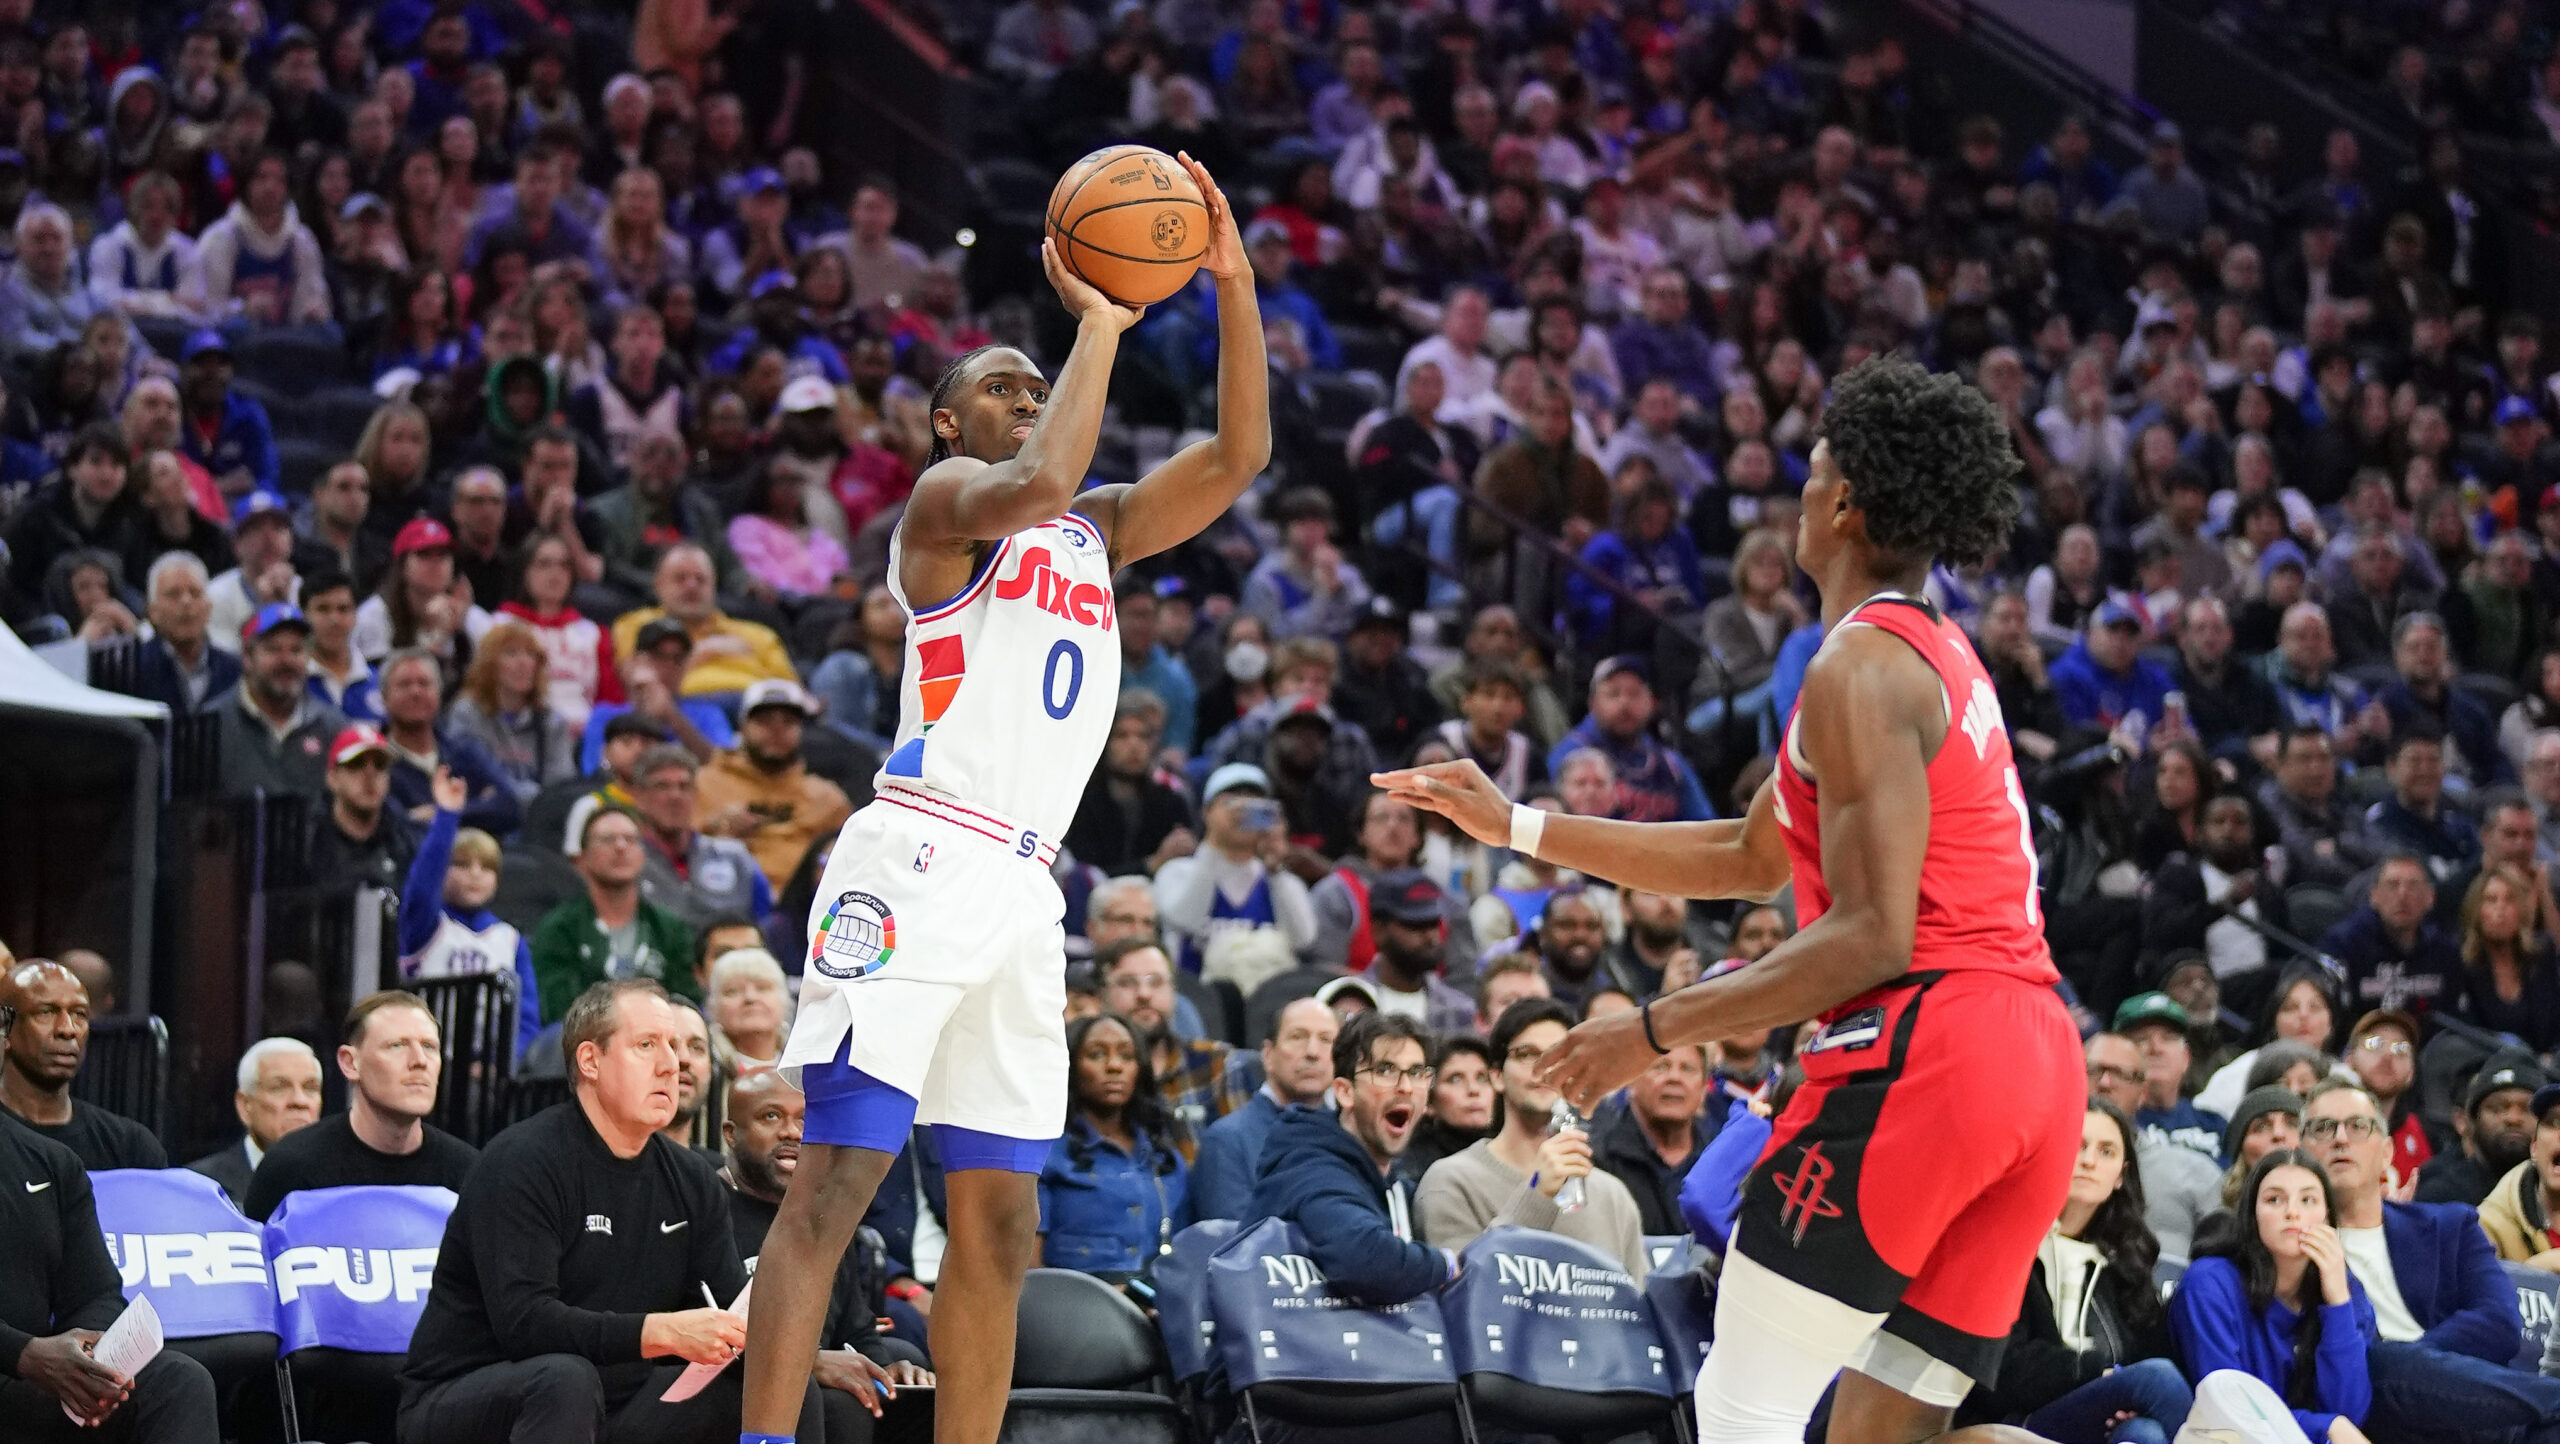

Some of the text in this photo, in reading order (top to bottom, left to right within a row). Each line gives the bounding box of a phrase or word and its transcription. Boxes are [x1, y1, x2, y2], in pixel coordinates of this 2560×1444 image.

[1043, 639, 1084, 720] 0
[1016, 830, 1038, 858] S
[843, 893, 885, 914] Spectrum
[1494, 1253, 1573, 1296] NJM
[1572, 1280, 1616, 1302] Group
